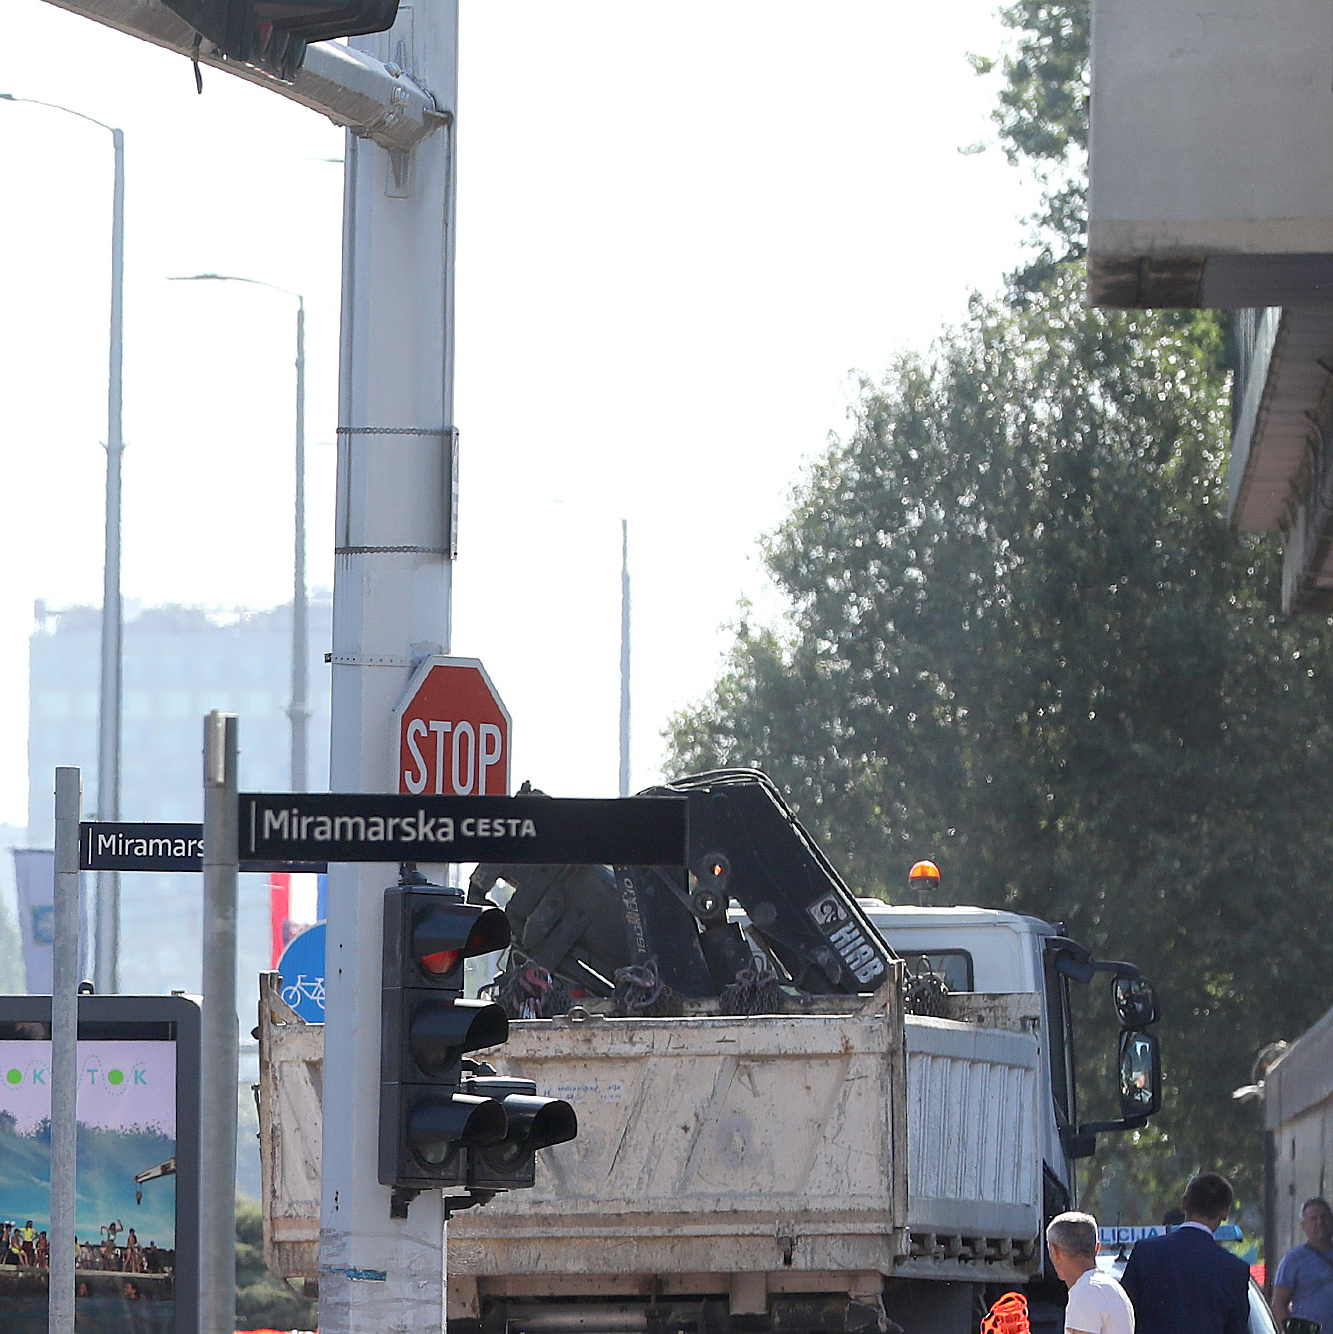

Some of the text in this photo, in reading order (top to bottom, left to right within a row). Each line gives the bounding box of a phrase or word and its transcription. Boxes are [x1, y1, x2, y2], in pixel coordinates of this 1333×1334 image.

[404, 718, 502, 797] STOP
[263, 809, 537, 842] Miramarska CESTA
[97, 833, 204, 857] Miramars
[829, 920, 885, 984] HIAB
[1100, 1227, 1160, 1243] LICIJA
